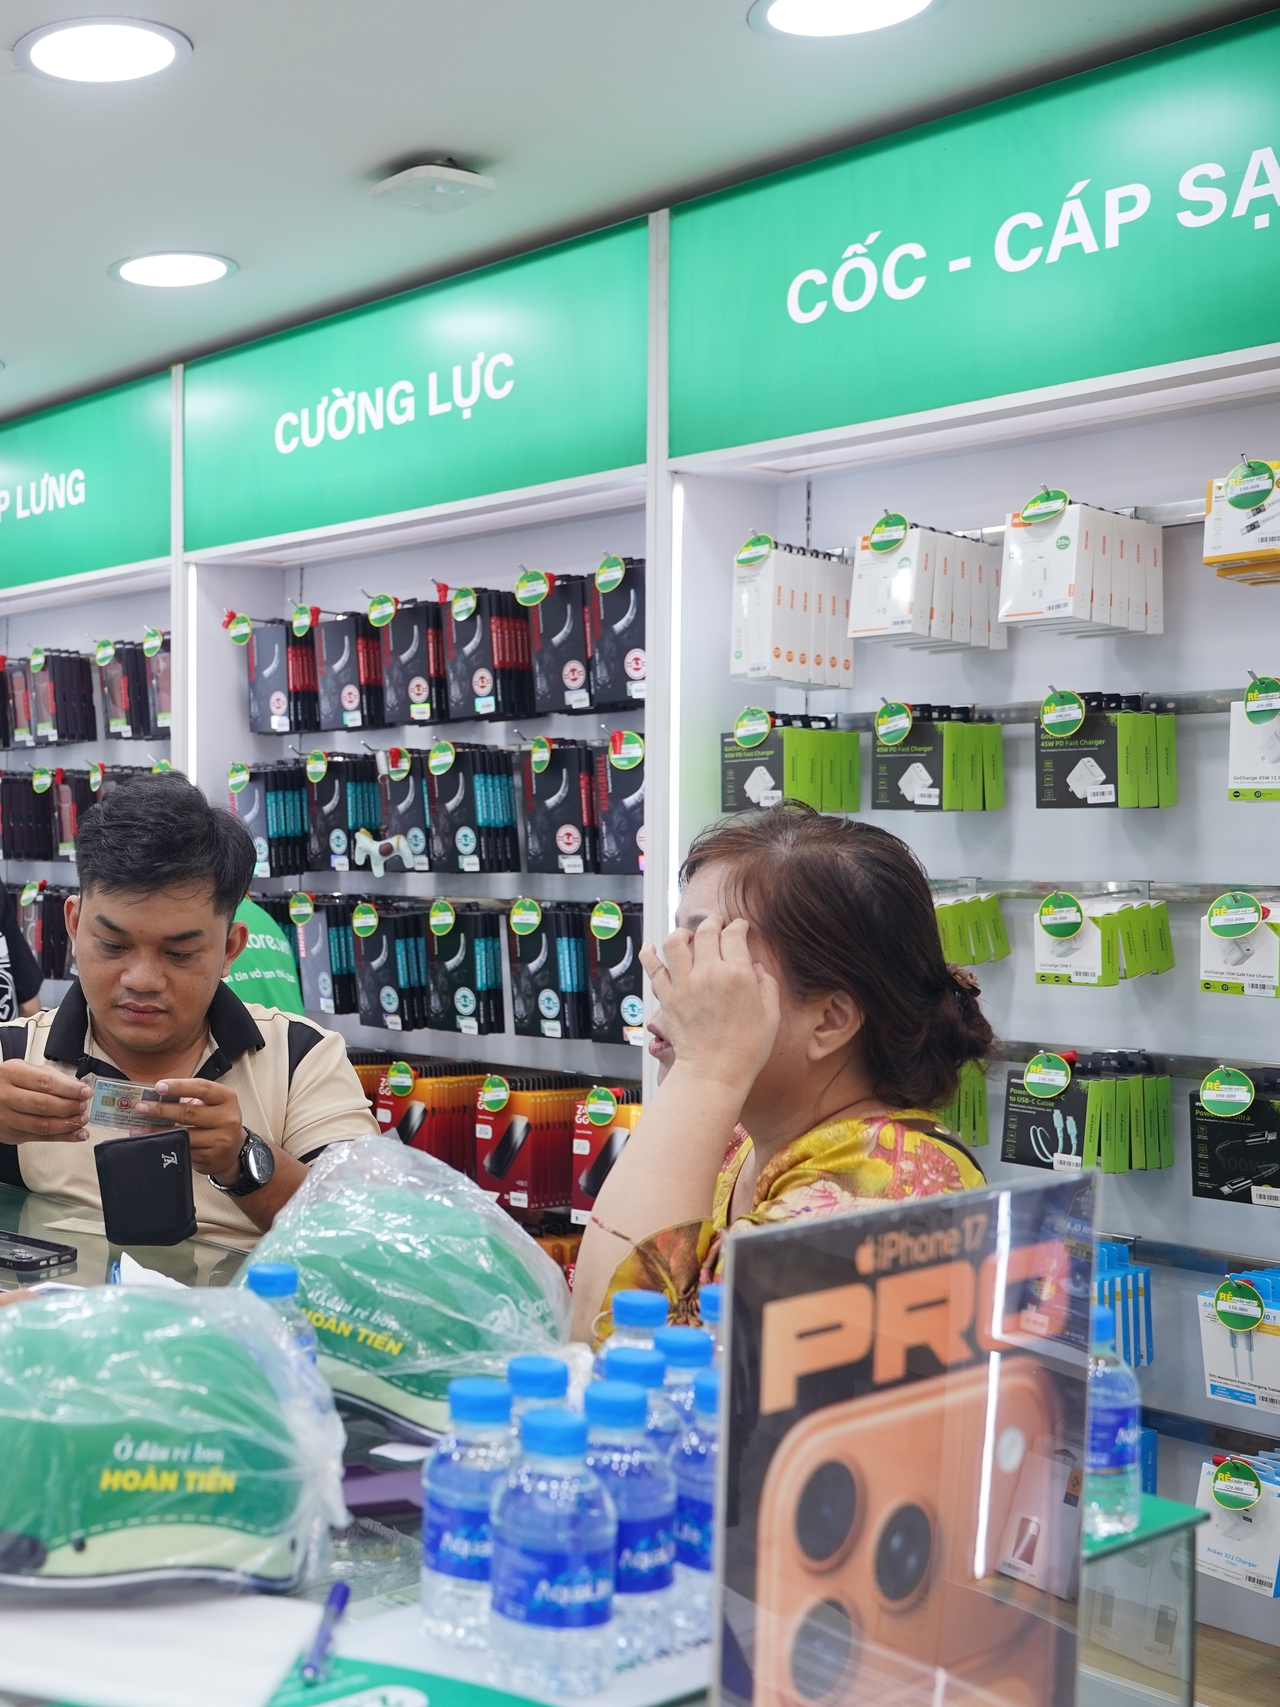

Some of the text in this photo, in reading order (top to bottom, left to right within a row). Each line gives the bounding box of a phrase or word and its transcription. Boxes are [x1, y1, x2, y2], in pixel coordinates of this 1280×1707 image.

[787, 146, 1280, 324] CỐC - CÁP SẠ
[275, 352, 515, 454] CƯỜNG LỰC
[16, 469, 86, 520] LƯNG
[1079, 739, 1105, 747] Charger
[596, 754, 609, 811] KINGBULL
[1042, 904, 1054, 915] RẺ
[1212, 905, 1227, 917] RẺ
[297, 924, 307, 958] KINGB
[1029, 1063, 1043, 1074] RẺ
[1206, 1080, 1220, 1091] RẺ
[1037, 1099, 1055, 1108] Cable
[876, 1213, 989, 1269] iPhone 17
[1219, 1291, 1233, 1301] RẺ
[356, 1326, 404, 1356] TIỀN
[100, 1464, 237, 1493] HOÀN TIỀN
[1218, 1472, 1231, 1483] RẺ
[1206, 1547, 1223, 1557] Anker
[1236, 1556, 1258, 1569] Charger
